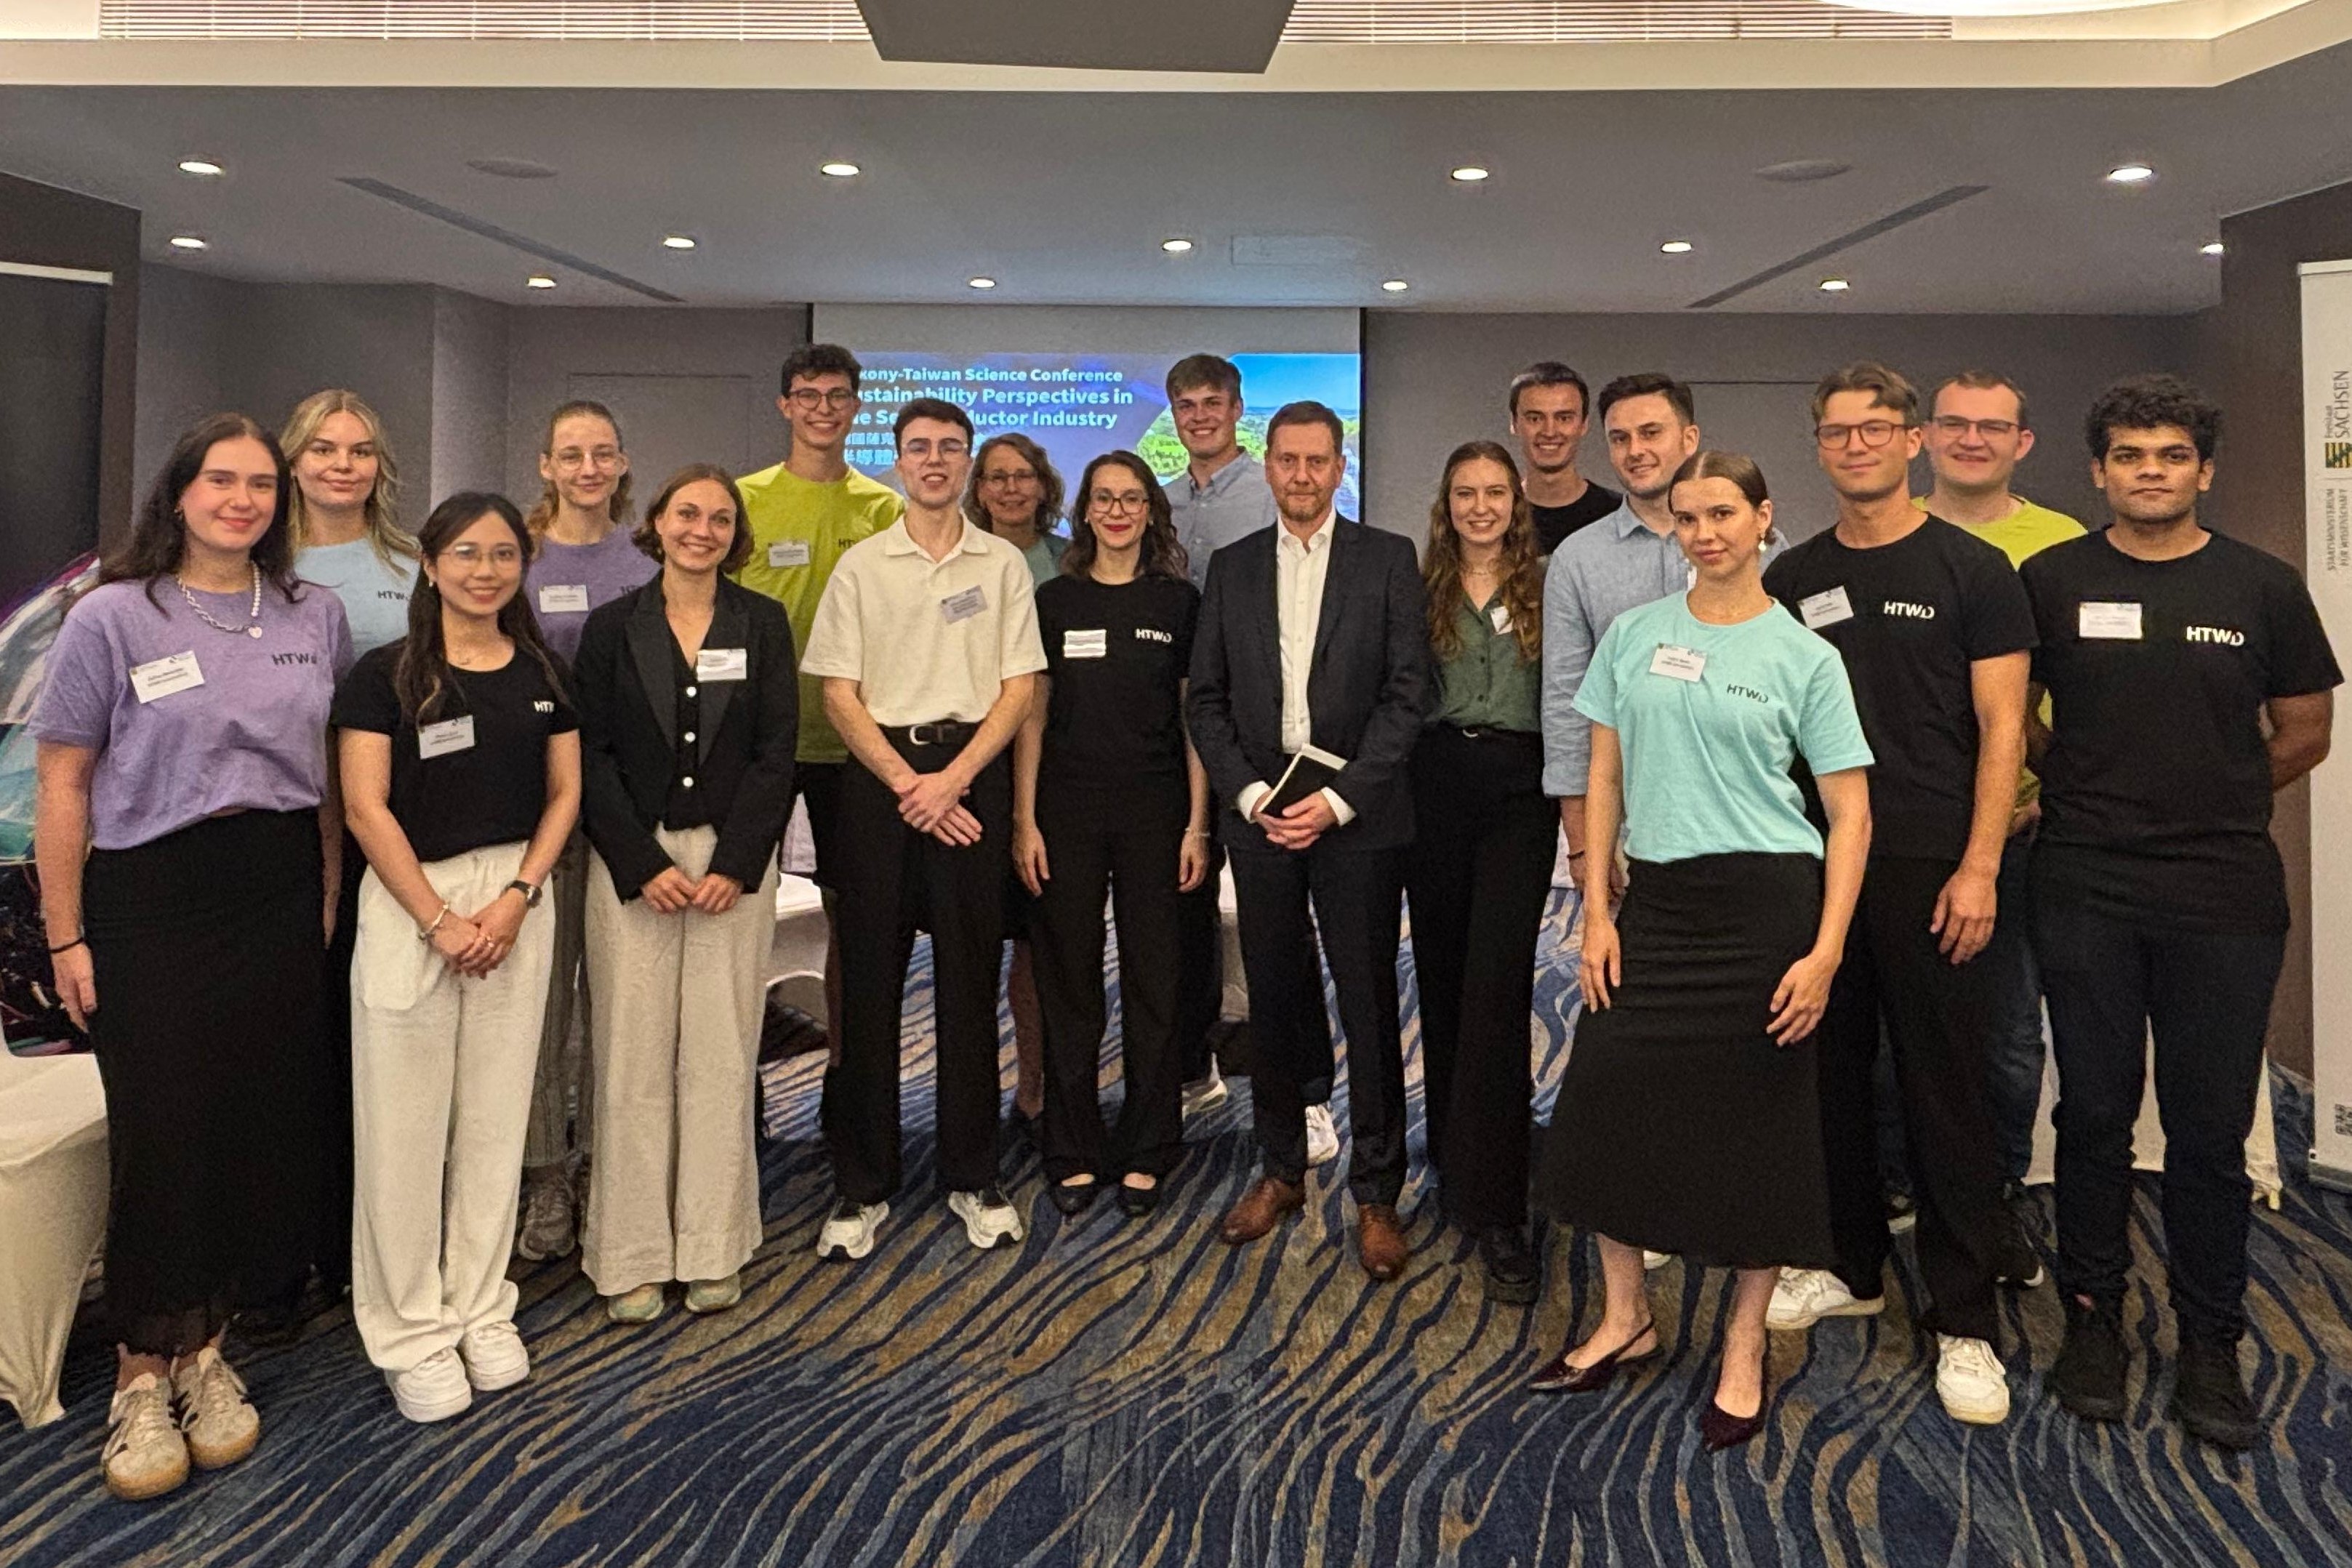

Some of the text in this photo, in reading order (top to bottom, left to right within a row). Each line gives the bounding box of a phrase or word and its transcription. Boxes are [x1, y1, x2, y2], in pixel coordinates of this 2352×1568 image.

[859, 367, 1123, 383] xony-Taiwan Science Conference
[982, 387, 1110, 406] Perspectives
[1113, 387, 1133, 404] in
[2333, 371, 2350, 438] SACHSEN
[1033, 410, 1117, 429] Industry
[1883, 600, 1935, 619] HTWD
[1135, 628, 1172, 643] HTWD
[2186, 626, 2244, 646] HTWD
[1727, 683, 1768, 704] HTWD
